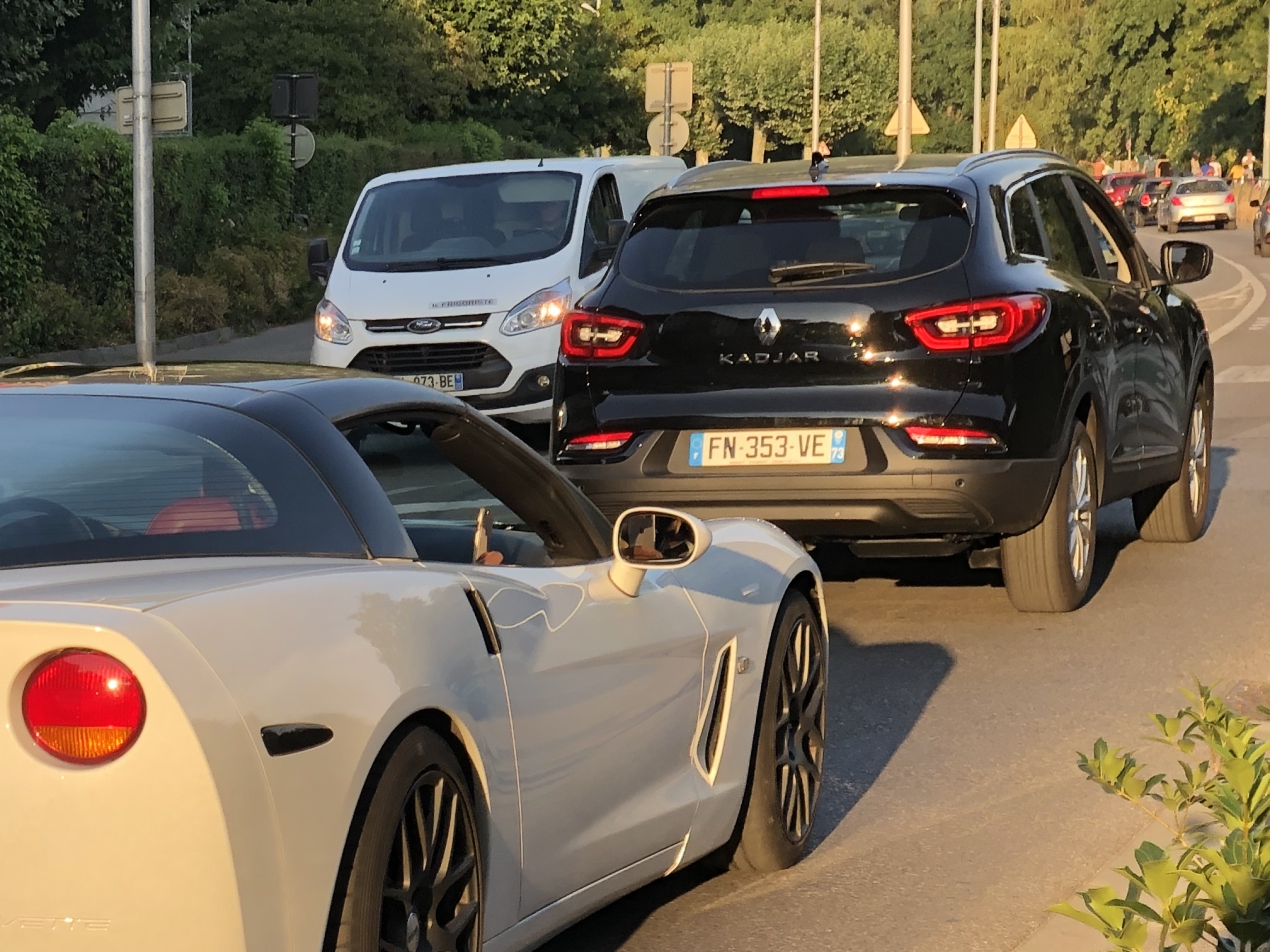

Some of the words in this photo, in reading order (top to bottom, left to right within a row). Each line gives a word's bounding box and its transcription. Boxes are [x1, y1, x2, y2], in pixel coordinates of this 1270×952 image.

[719, 351, 820, 364] KADJAR
[693, 452, 699, 460] F
[708, 434, 826, 459] FN-353-VE
[831, 447, 845, 459] 73
